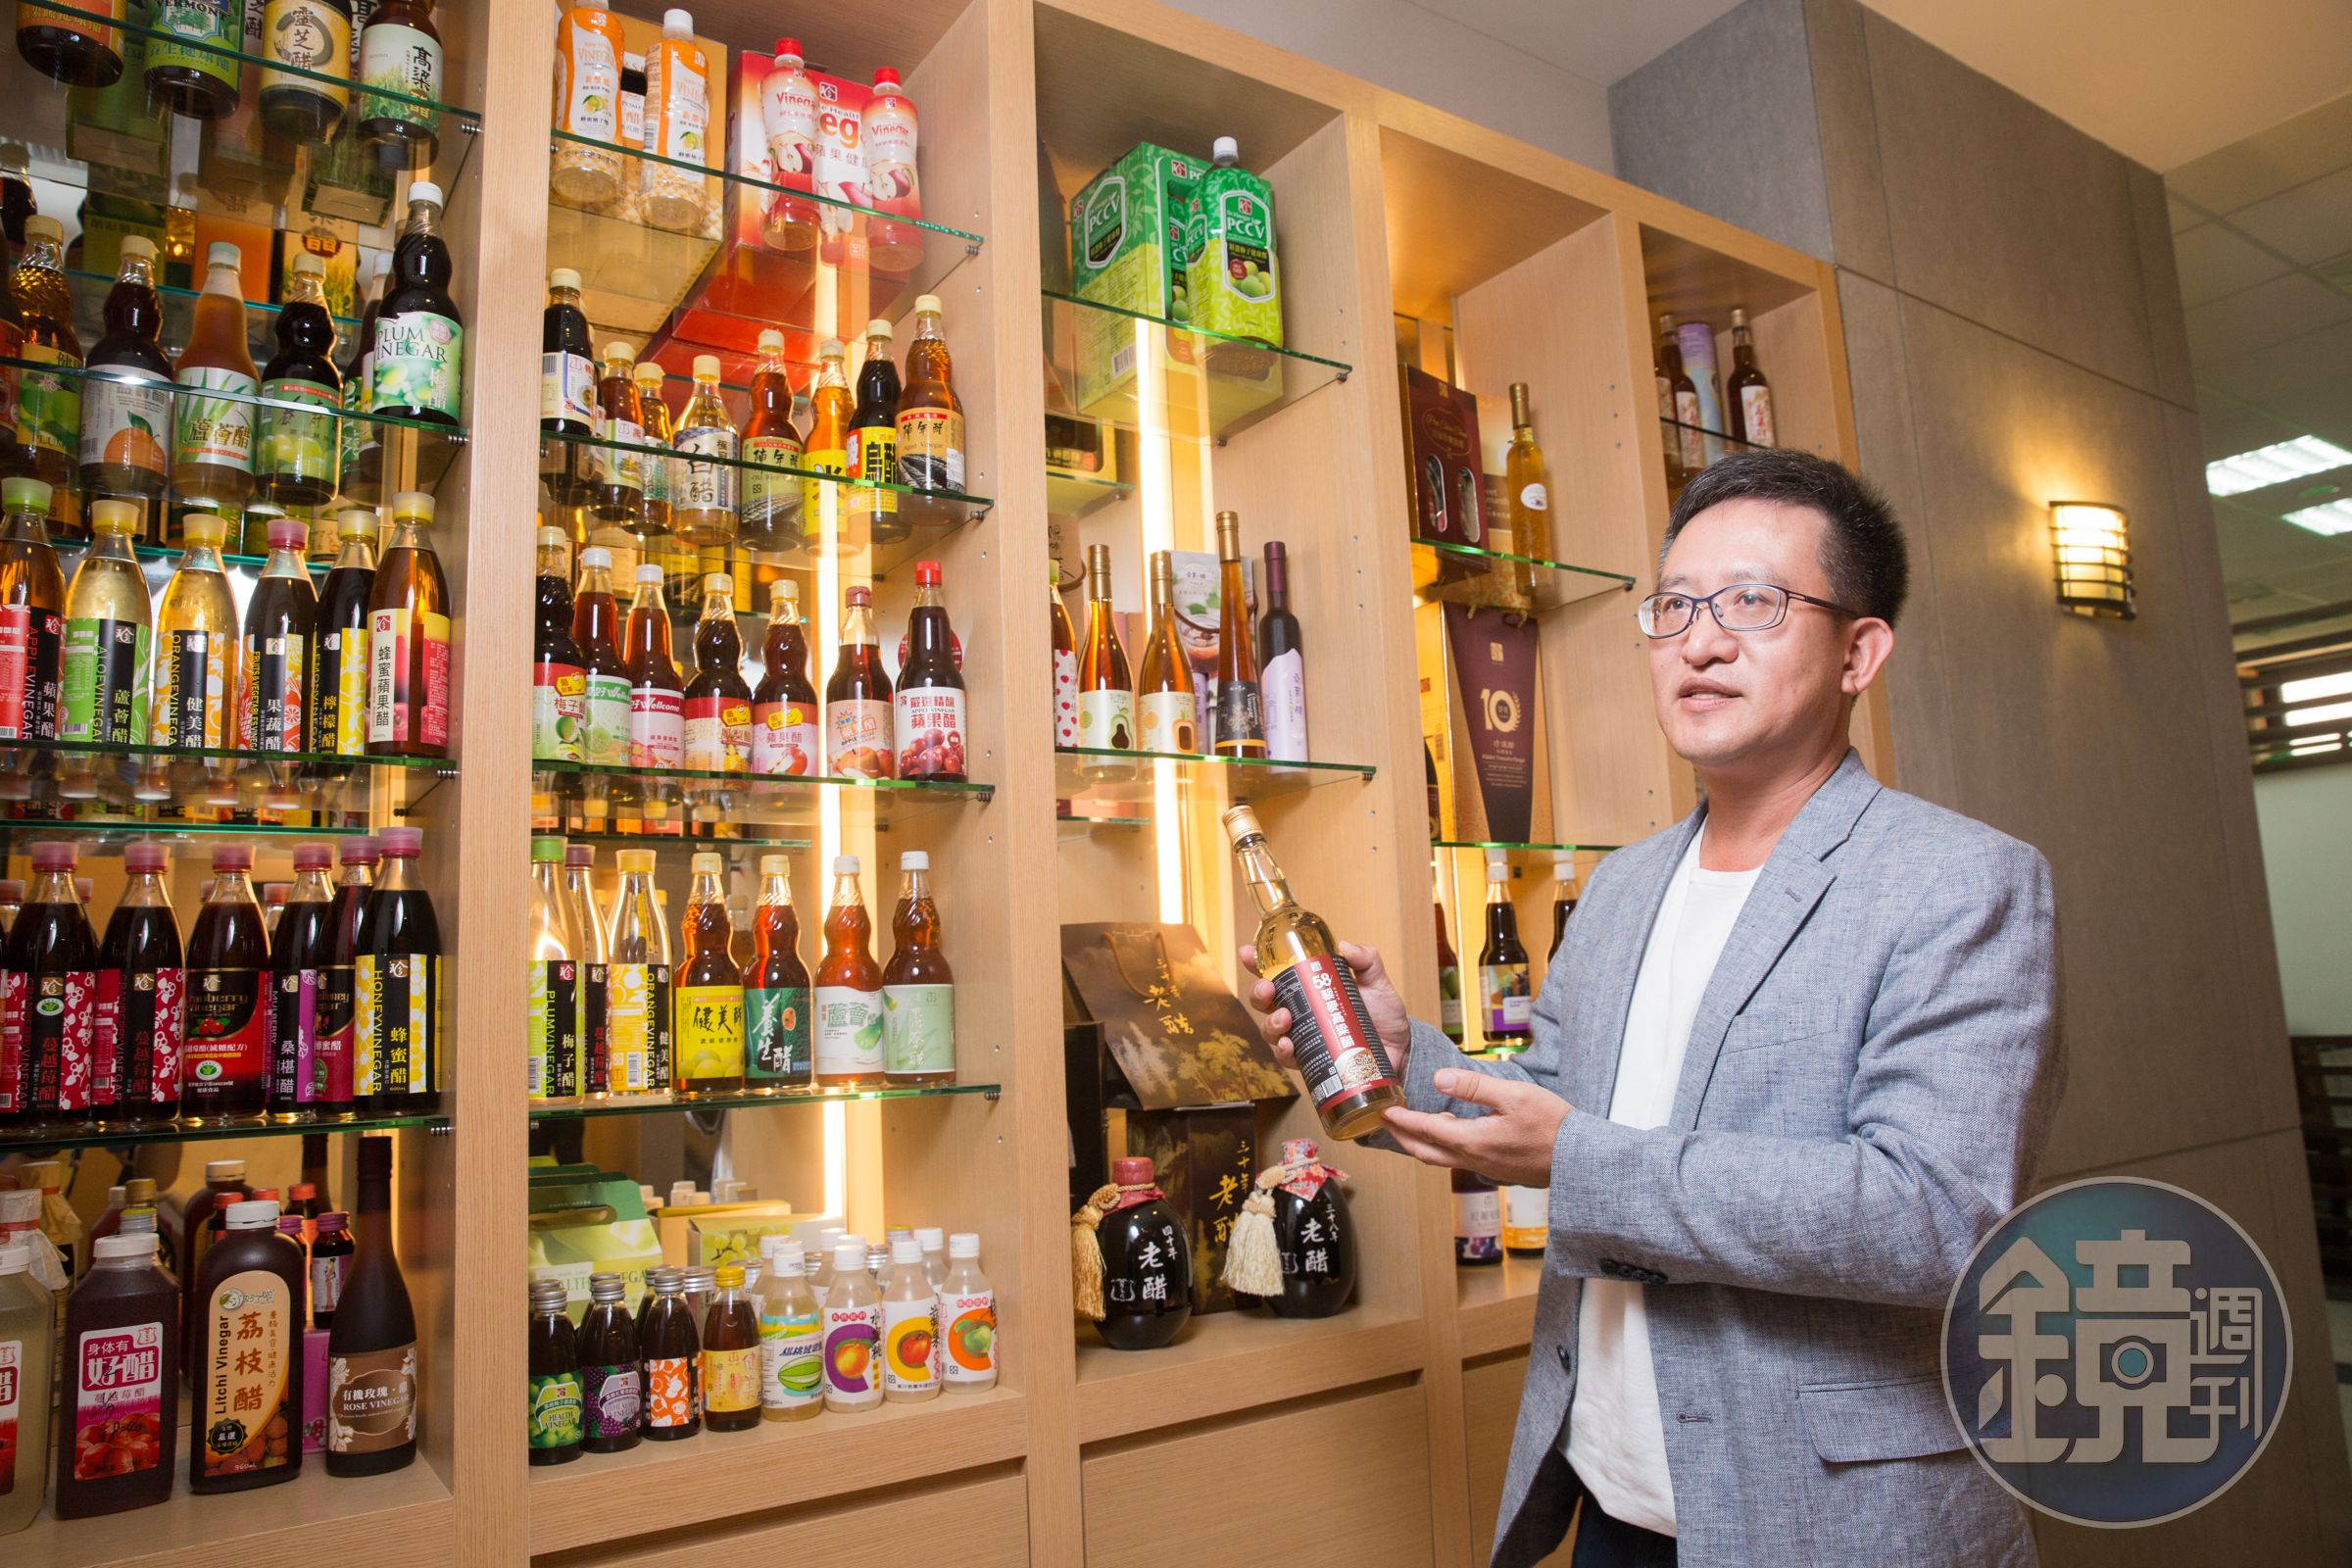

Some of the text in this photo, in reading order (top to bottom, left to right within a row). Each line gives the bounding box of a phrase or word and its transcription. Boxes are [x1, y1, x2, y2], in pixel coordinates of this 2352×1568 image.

[291, 7, 314, 71] 靈芝醋
[1227, 218, 1265, 239] PCCV
[376, 326, 424, 344] PLUM
[188, 417, 251, 449] 蘆薈醋
[40, 680, 58, 738] 蘋果醋
[375, 646, 392, 727] 蜂蜜蘋果醋
[640, 697, 680, 712] Wellcome
[111, 688, 131, 744] 蘆薈醋
[184, 696, 204, 749] 健美醋
[264, 698, 282, 752] 果蔬醋
[320, 695, 338, 749] 檸檬醋
[910, 712, 956, 729] 蘋果醋
[279, 1040, 296, 1095] 桑椹醋
[389, 1026, 409, 1085] 蜂蜜醋
[561, 1033, 575, 1088] 梅子醋
[659, 1031, 669, 1081] 健美醋
[1160, 1224, 1179, 1260] 四十年
[1299, 1217, 1329, 1273] 老醋
[1325, 1201, 1341, 1243] 三十八年
[1137, 1241, 1168, 1301] 老醋
[86, 1349, 156, 1388] 好醋
[87, 1339, 129, 1356] 身体有
[215, 1315, 232, 1415] Litchi Vinegar
[233, 1310, 265, 1412] 荔枝醋
[343, 1394, 411, 1412] ROSE VINEGAR
[548, 1410, 574, 1422] HEALTH
